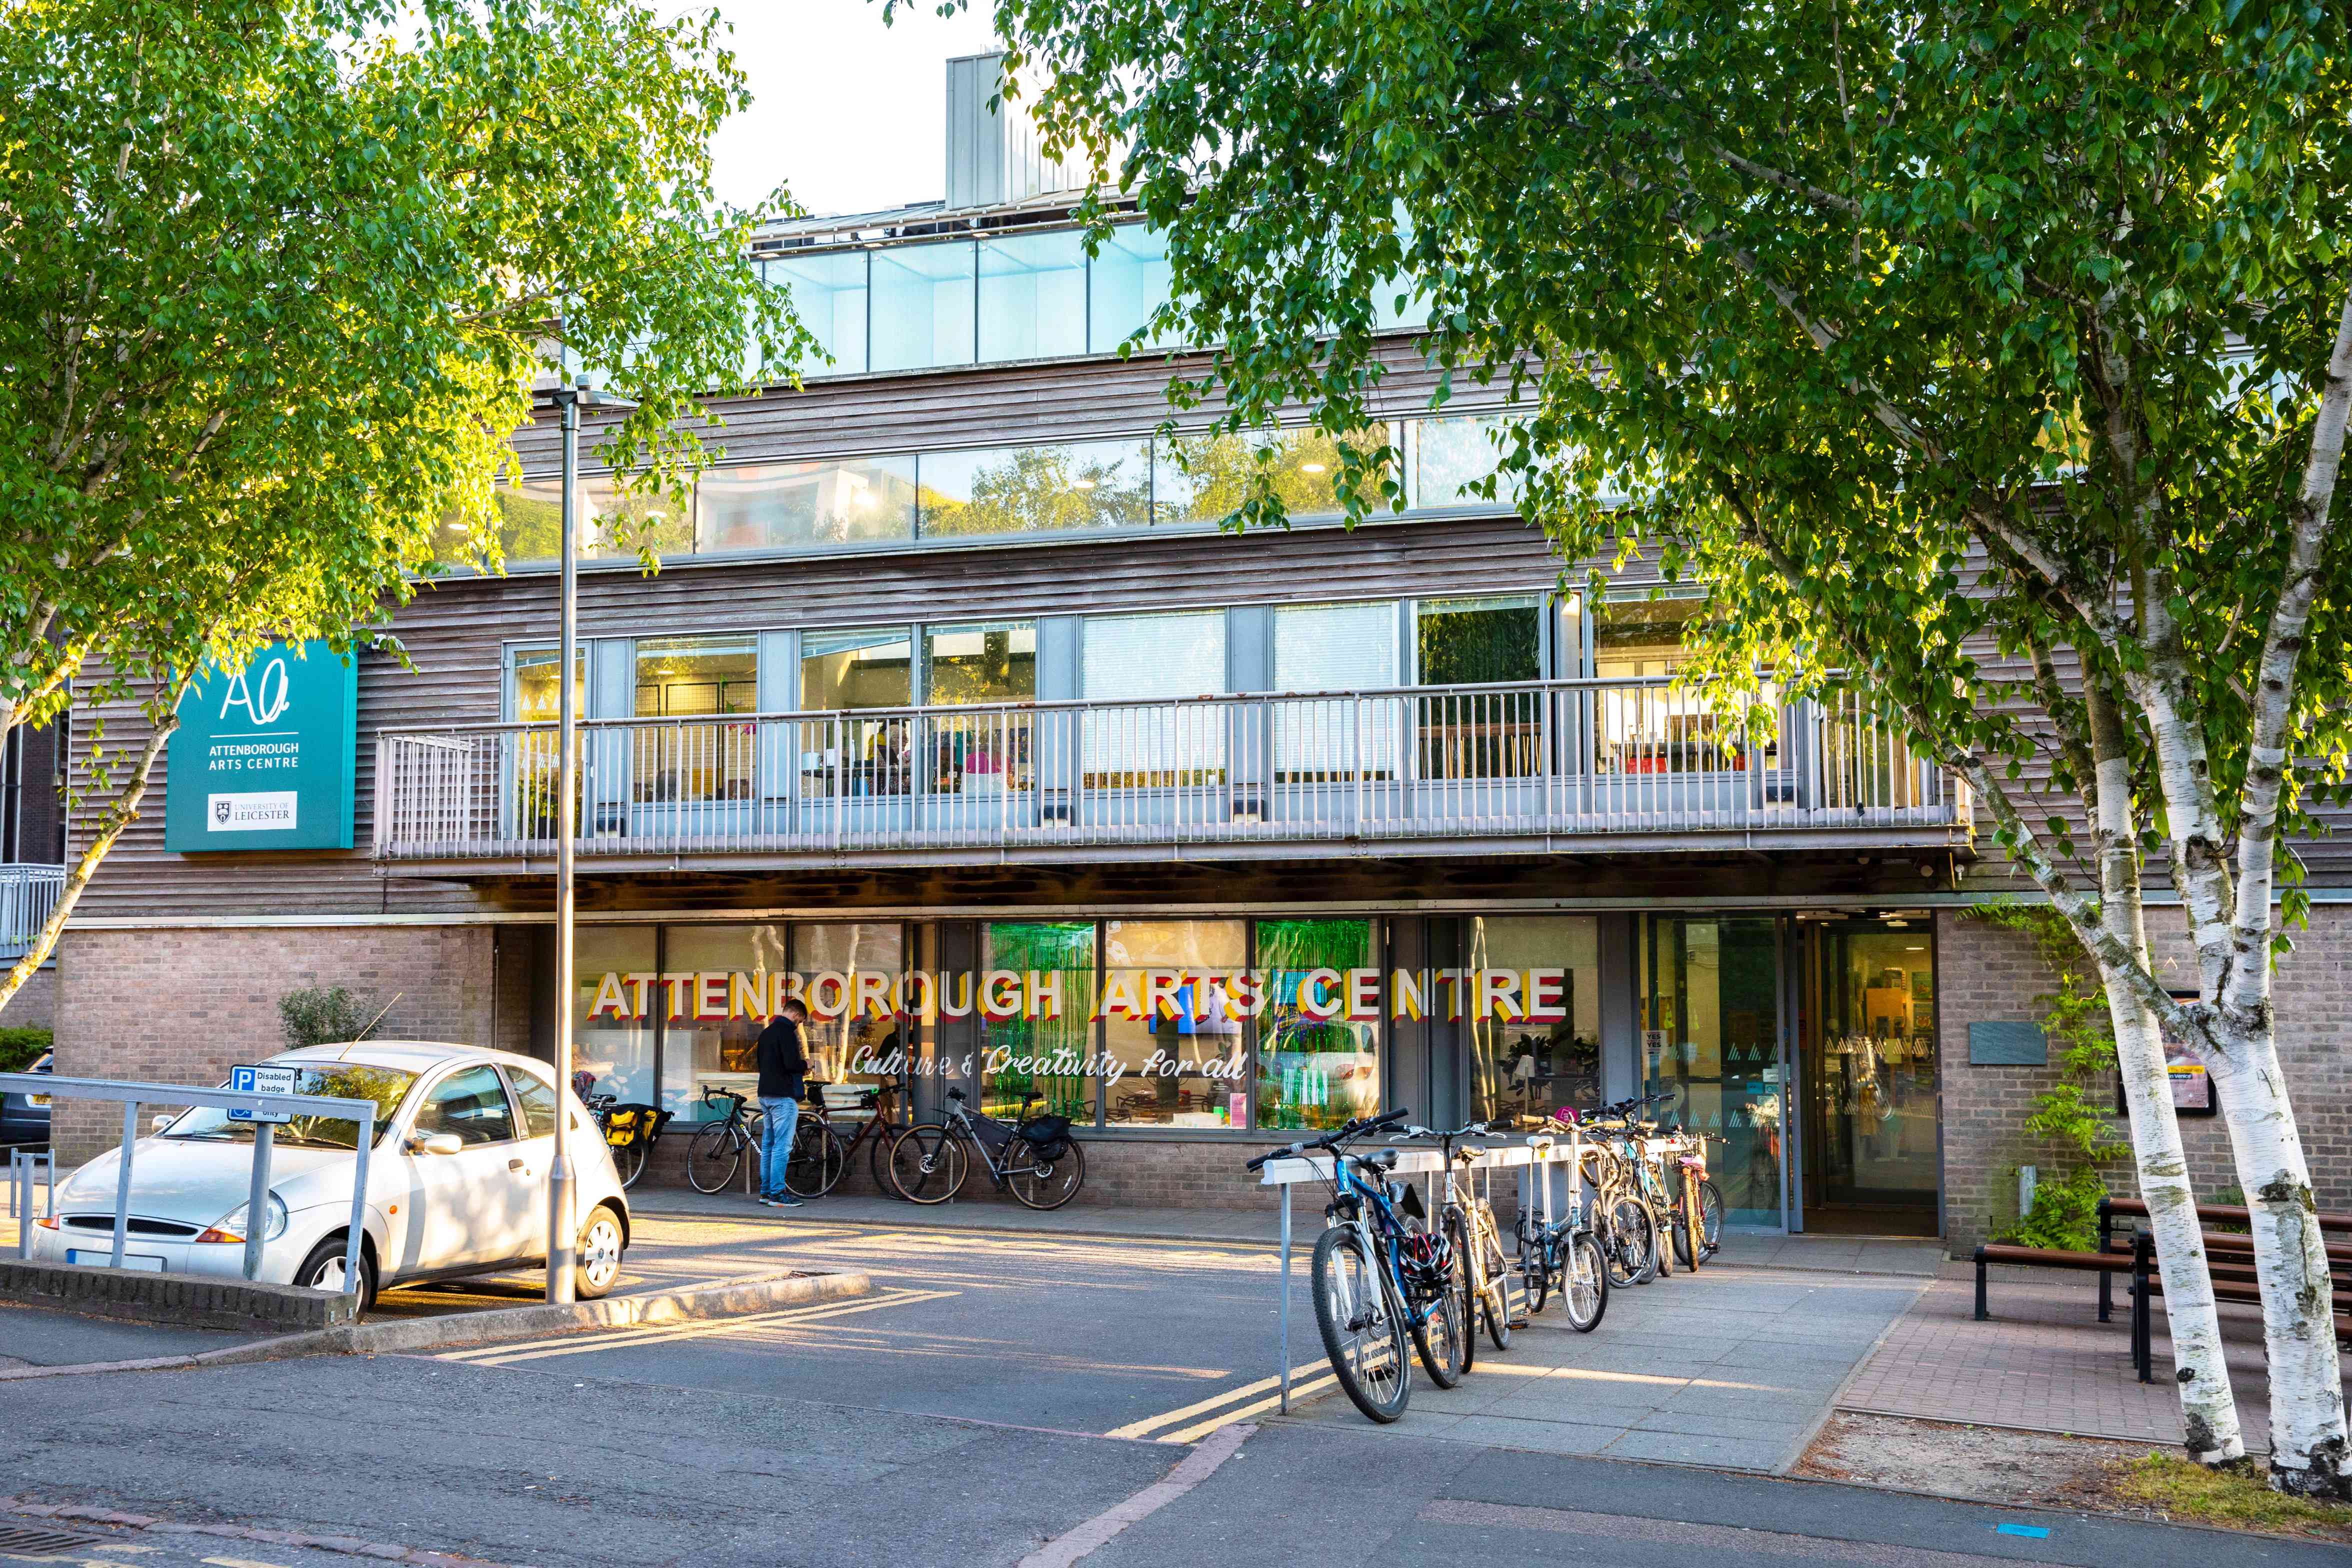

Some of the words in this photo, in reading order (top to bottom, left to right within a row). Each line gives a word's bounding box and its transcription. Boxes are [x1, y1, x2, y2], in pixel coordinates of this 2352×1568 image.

[209, 742, 299, 756] ATTENBOROUGH
[209, 759, 242, 770] ARTS
[248, 757, 299, 769] CENTRE
[235, 810, 290, 820] LEICESTER
[586, 969, 1061, 1022] ATTENBOROUGH
[1088, 968, 1264, 1023] ARTS
[1296, 968, 1566, 1023] CENTRE
[852, 1045, 954, 1076] Culture
[961, 1052, 974, 1078] &
[987, 1044, 1127, 1086] Creativity
[1141, 1048, 1194, 1077] for
[1202, 1051, 1248, 1080] all
[238, 1071, 252, 1090] P
[257, 1072, 291, 1080] Disabled
[261, 1084, 285, 1093] badge
